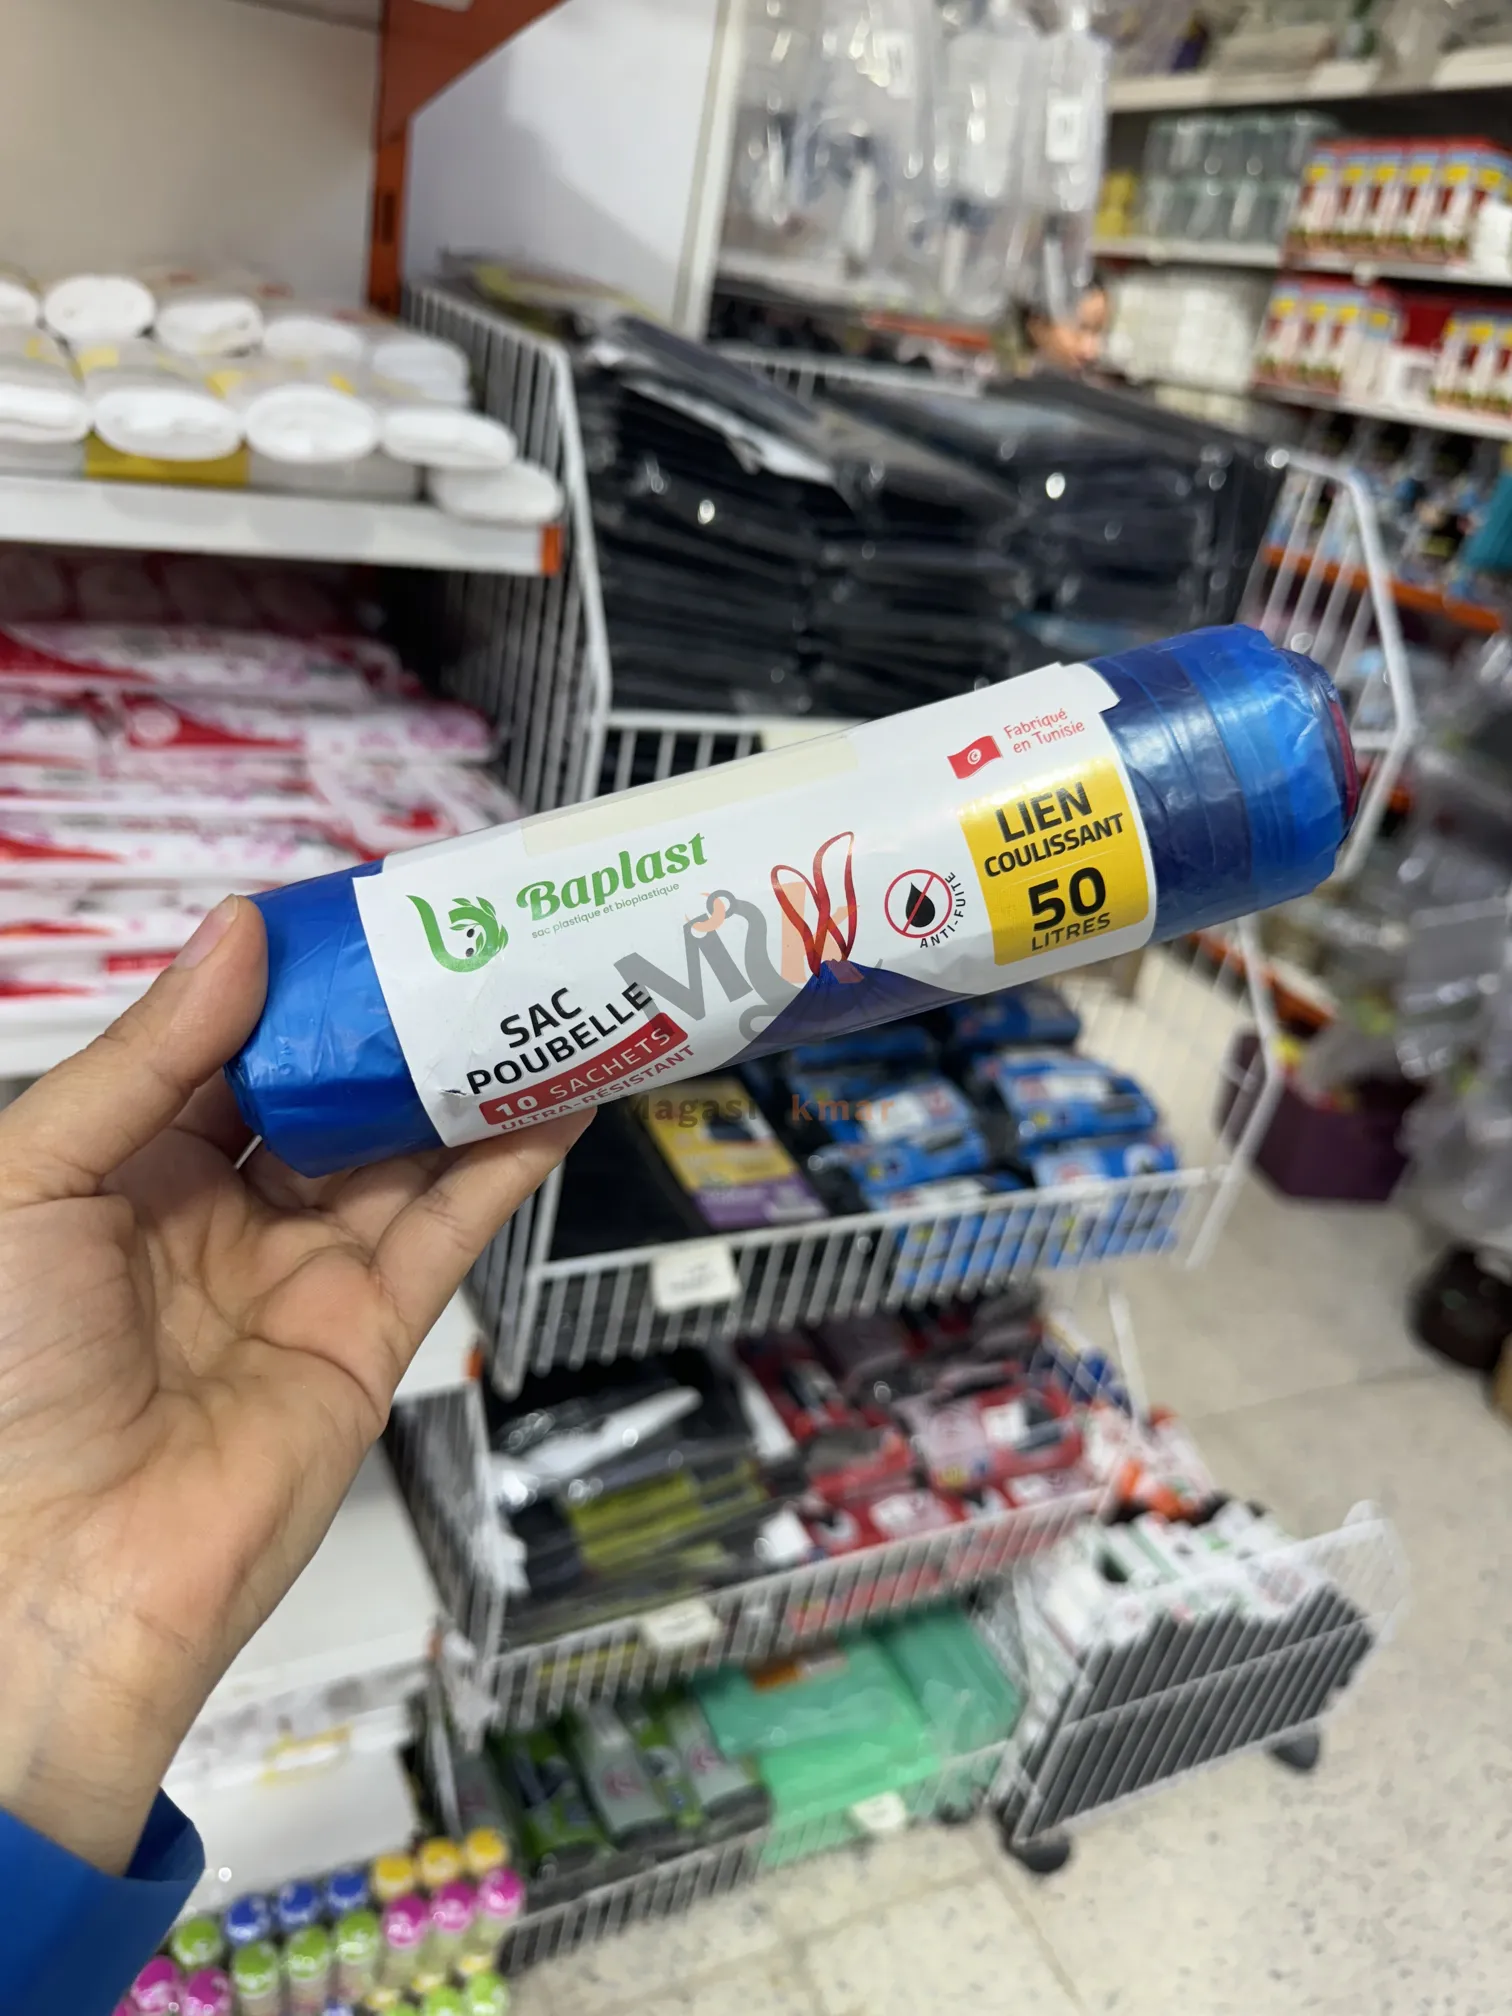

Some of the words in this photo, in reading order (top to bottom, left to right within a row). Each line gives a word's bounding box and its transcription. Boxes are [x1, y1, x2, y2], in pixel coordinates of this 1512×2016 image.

[1003, 708, 1068, 740] Fabriqué
[1013, 739, 1032, 754] en
[1032, 720, 1086, 746] Tunisie
[995, 781, 1093, 843] LIEN
[516, 832, 708, 921] Baplast
[984, 812, 1124, 878] COULISSANT
[531, 926, 551, 939] sac
[552, 911, 601, 936] plastique
[603, 904, 614, 915] et
[614, 883, 680, 910] bioplastique
[920, 871, 966, 949] ANTI-FUITE
[1028, 867, 1107, 932] 50
[1031, 912, 1111, 952] LITRES
[466, 982, 654, 1095] POUBELLE
[500, 987, 582, 1049] SAC
[495, 1095, 539, 1117] 10
[550, 1027, 671, 1100] SACHETS
[501, 1044, 695, 1131] ULTRA-RÉSISTANT
